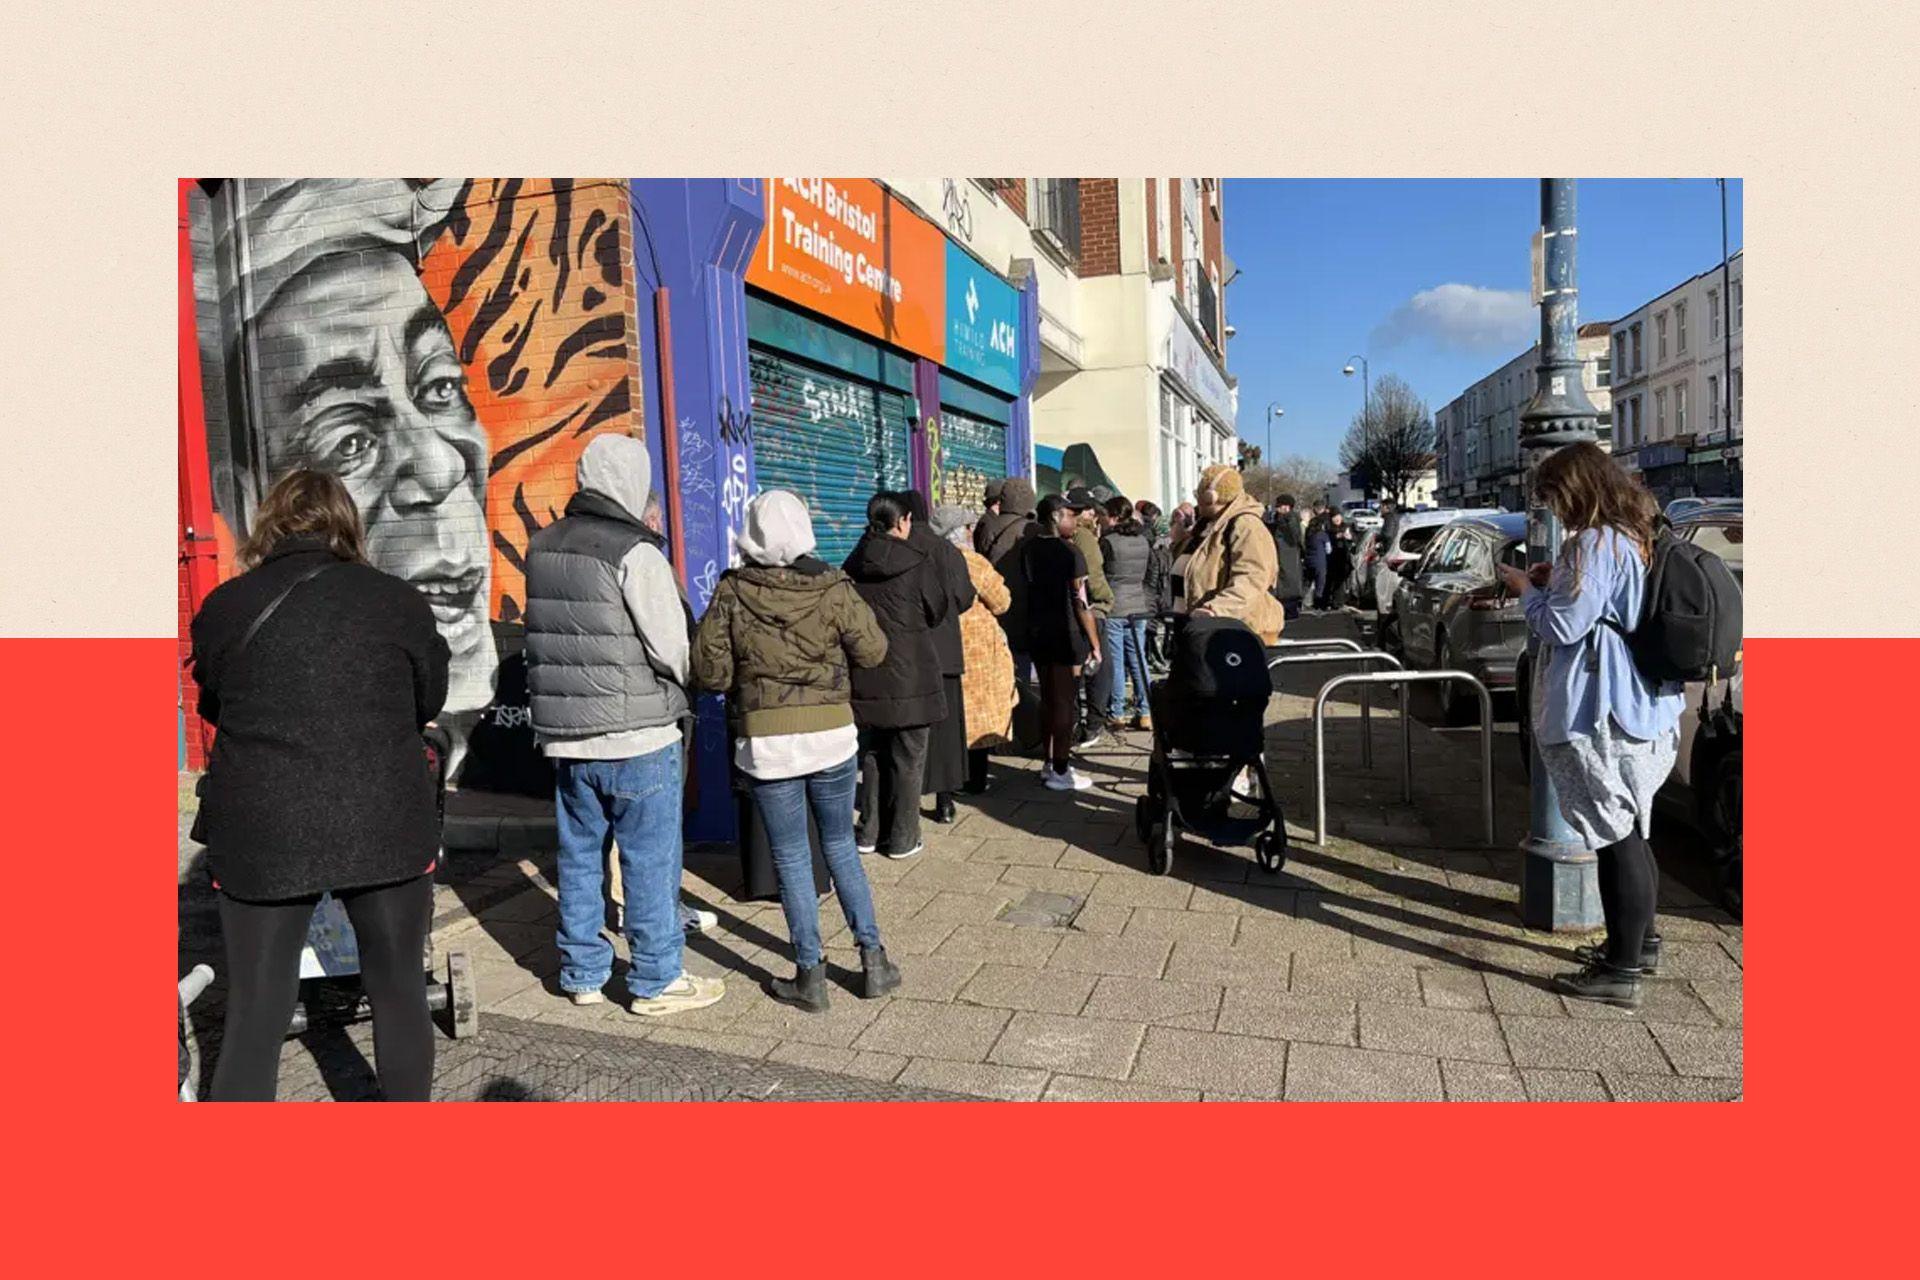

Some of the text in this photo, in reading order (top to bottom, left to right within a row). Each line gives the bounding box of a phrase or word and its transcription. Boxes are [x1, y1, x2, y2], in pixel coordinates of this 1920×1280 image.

[825, 181, 876, 243] Bristol
[782, 206, 902, 303] Training Centre
[990, 318, 1015, 358] ACH
